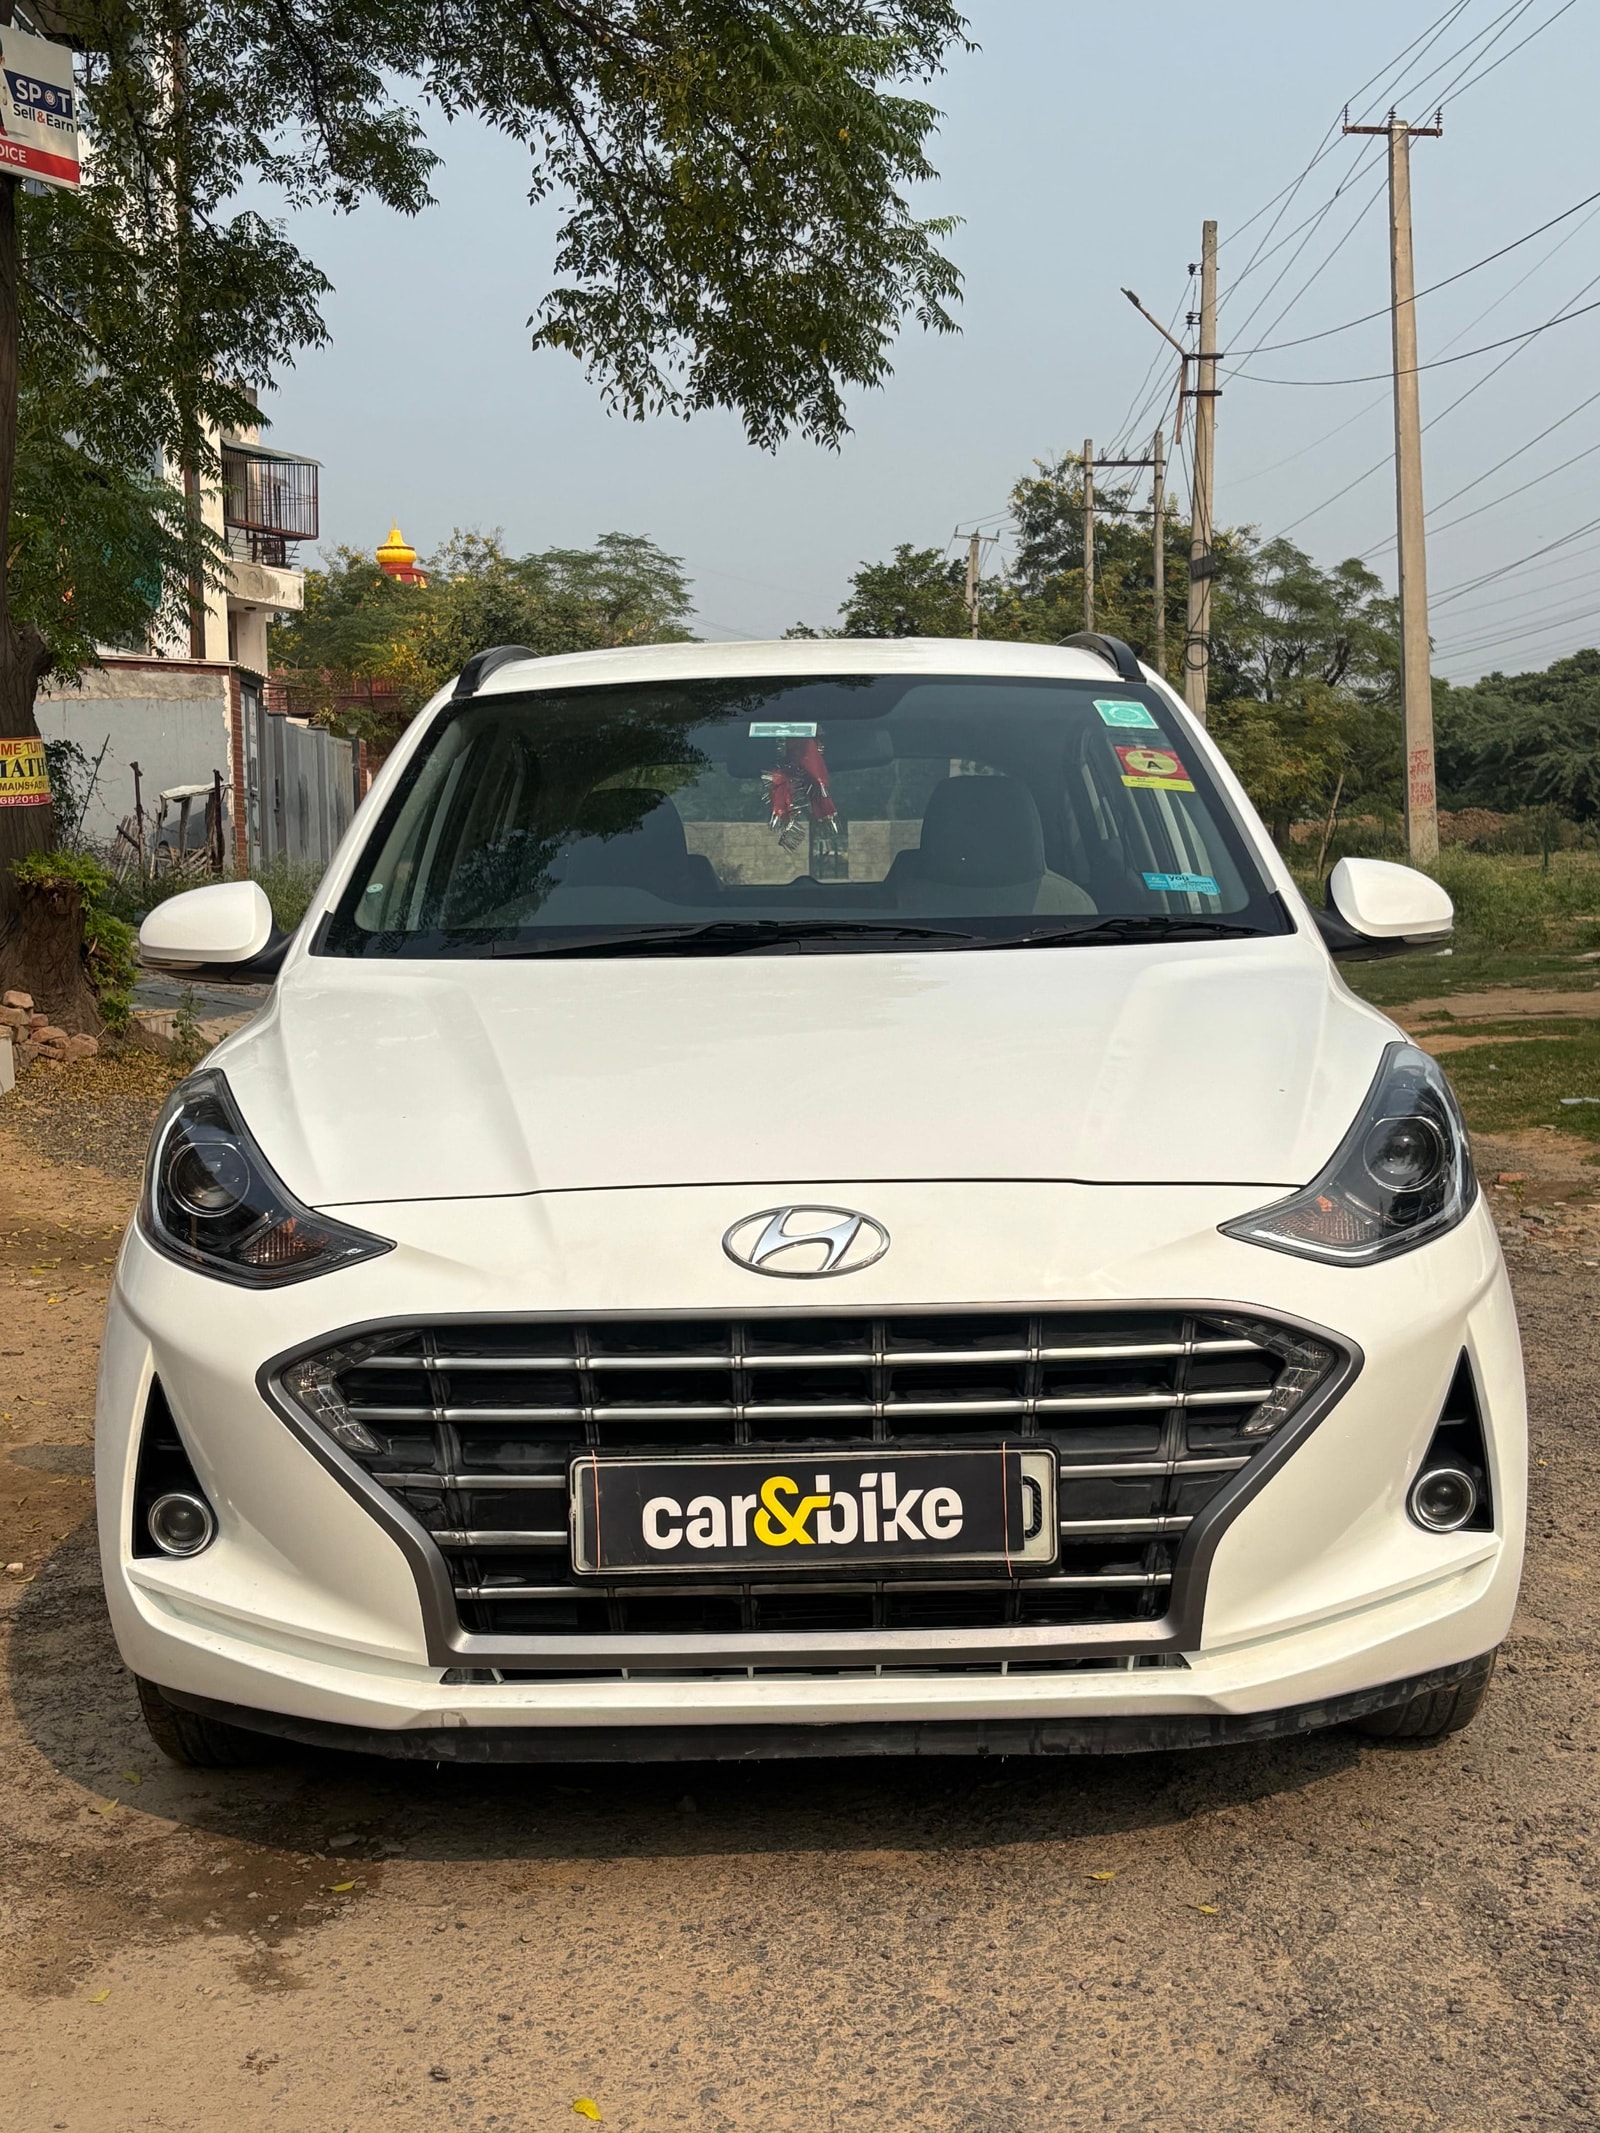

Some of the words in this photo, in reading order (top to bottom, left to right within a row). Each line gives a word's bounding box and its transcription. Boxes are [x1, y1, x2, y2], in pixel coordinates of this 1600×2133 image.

[13, 103, 74, 133] Sell&Earn
[1147, 761, 1162, 770] A
[641, 1470, 964, 1550] car&bike
